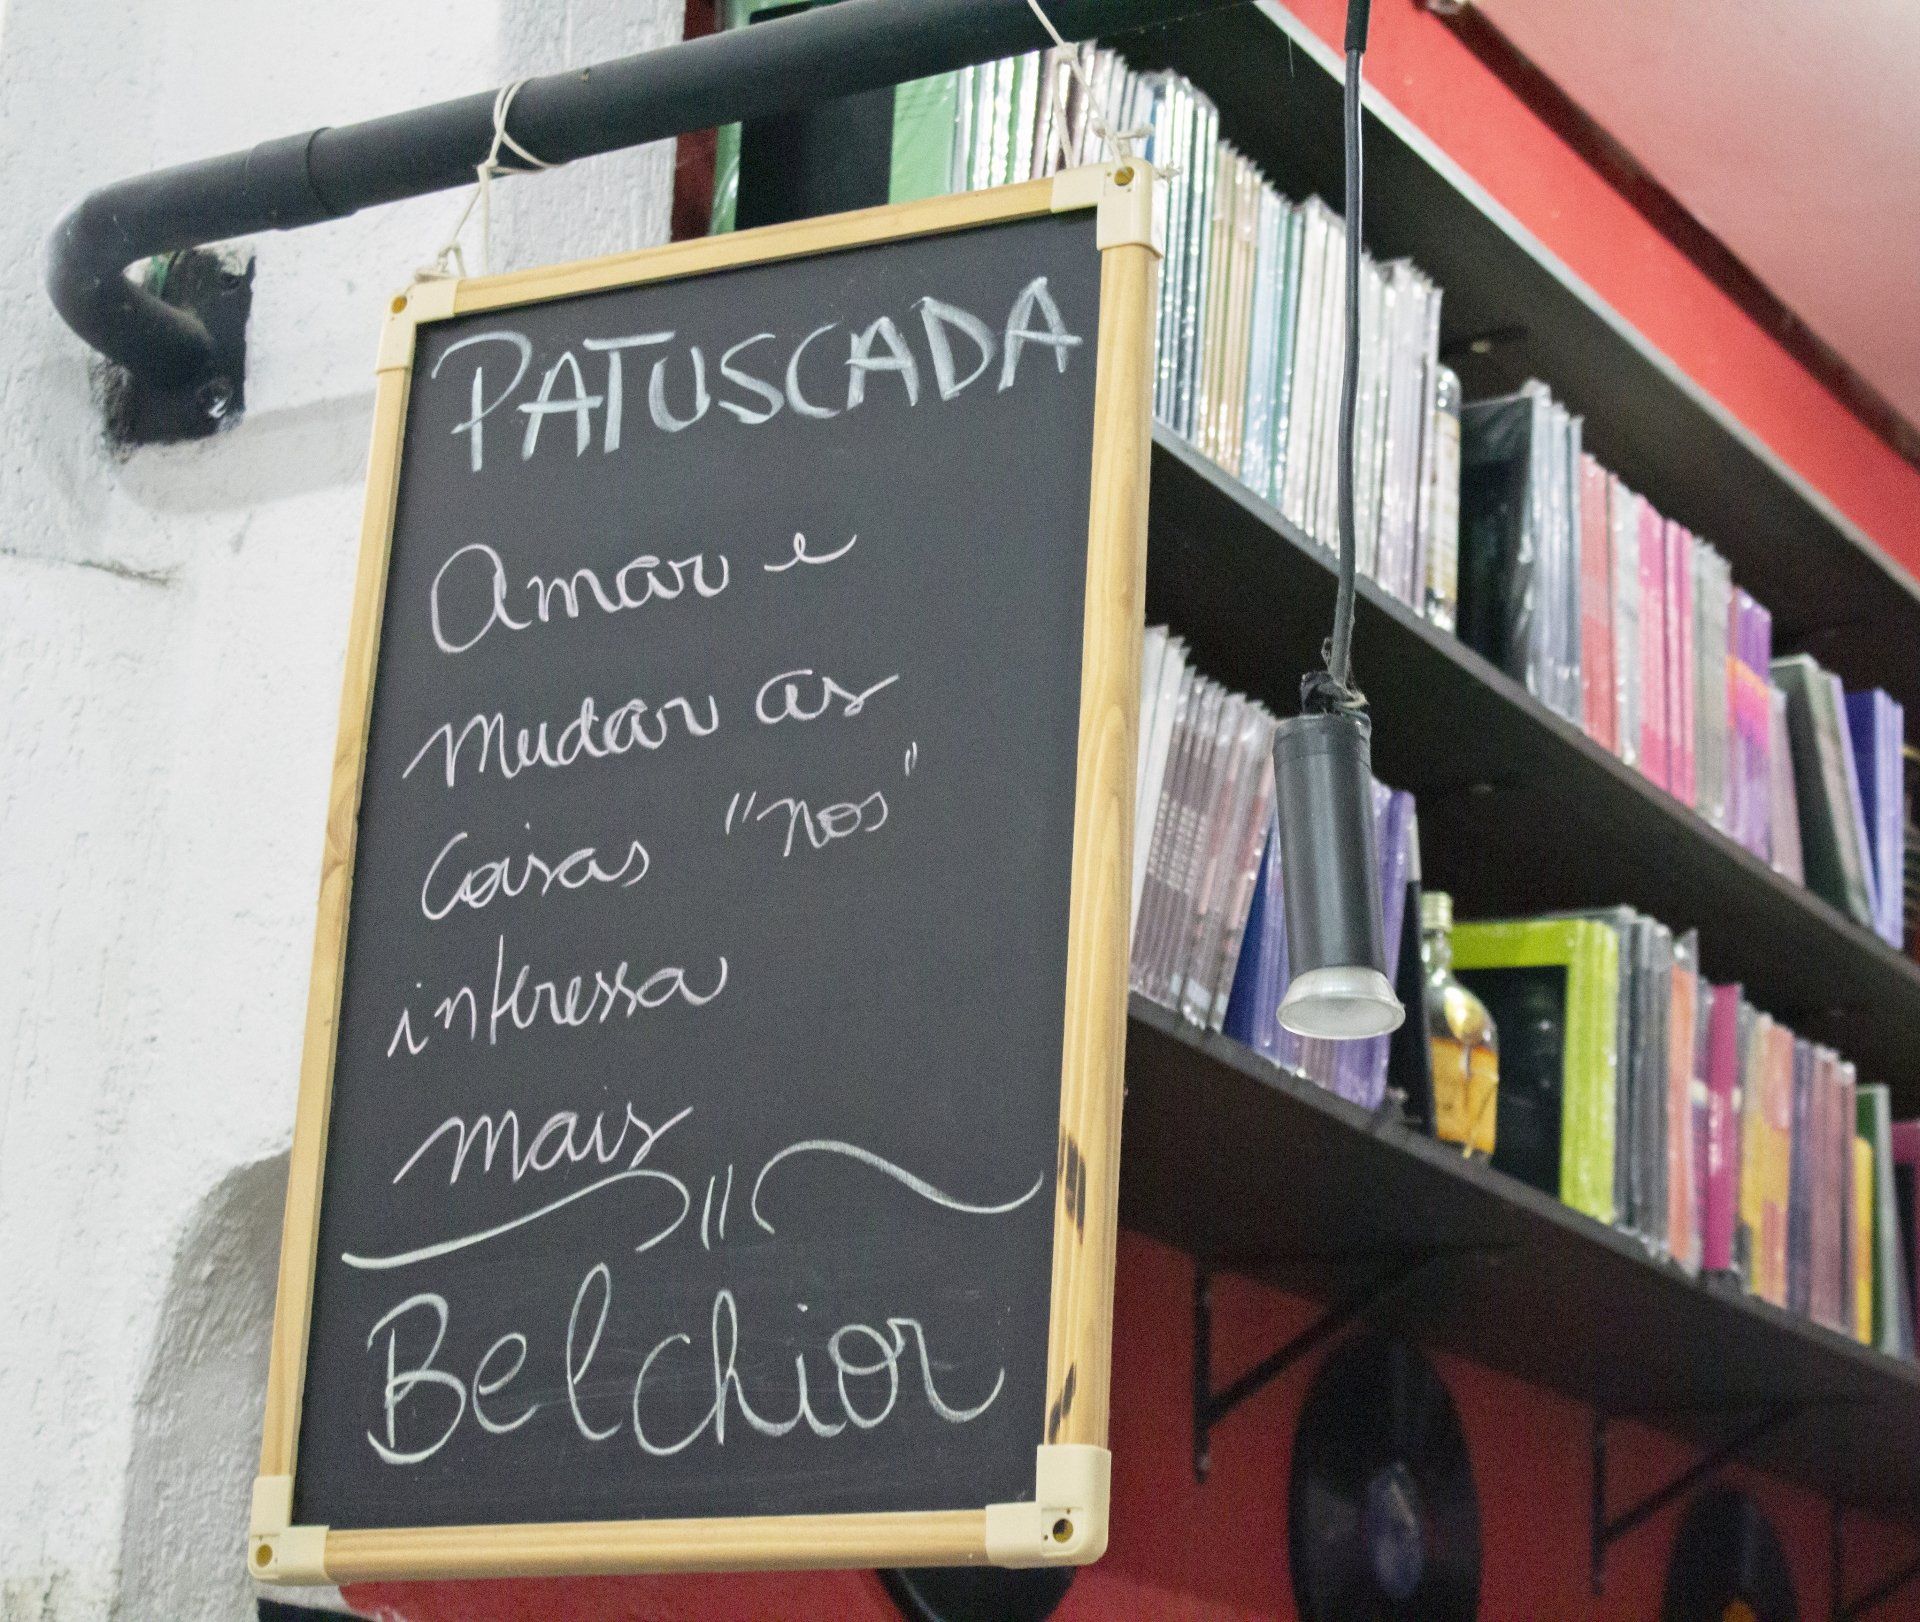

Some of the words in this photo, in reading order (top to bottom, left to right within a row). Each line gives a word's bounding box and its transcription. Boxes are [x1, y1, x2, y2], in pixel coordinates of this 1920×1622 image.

[430, 276, 1083, 472] PATUSCADA
[430, 543, 729, 654] Amar
[764, 532, 857, 572] e
[755, 669, 899, 724] as
[387, 934, 728, 1057] interessa
[393, 1086, 693, 1184] mais
[367, 1262, 1004, 1464] Belchior
